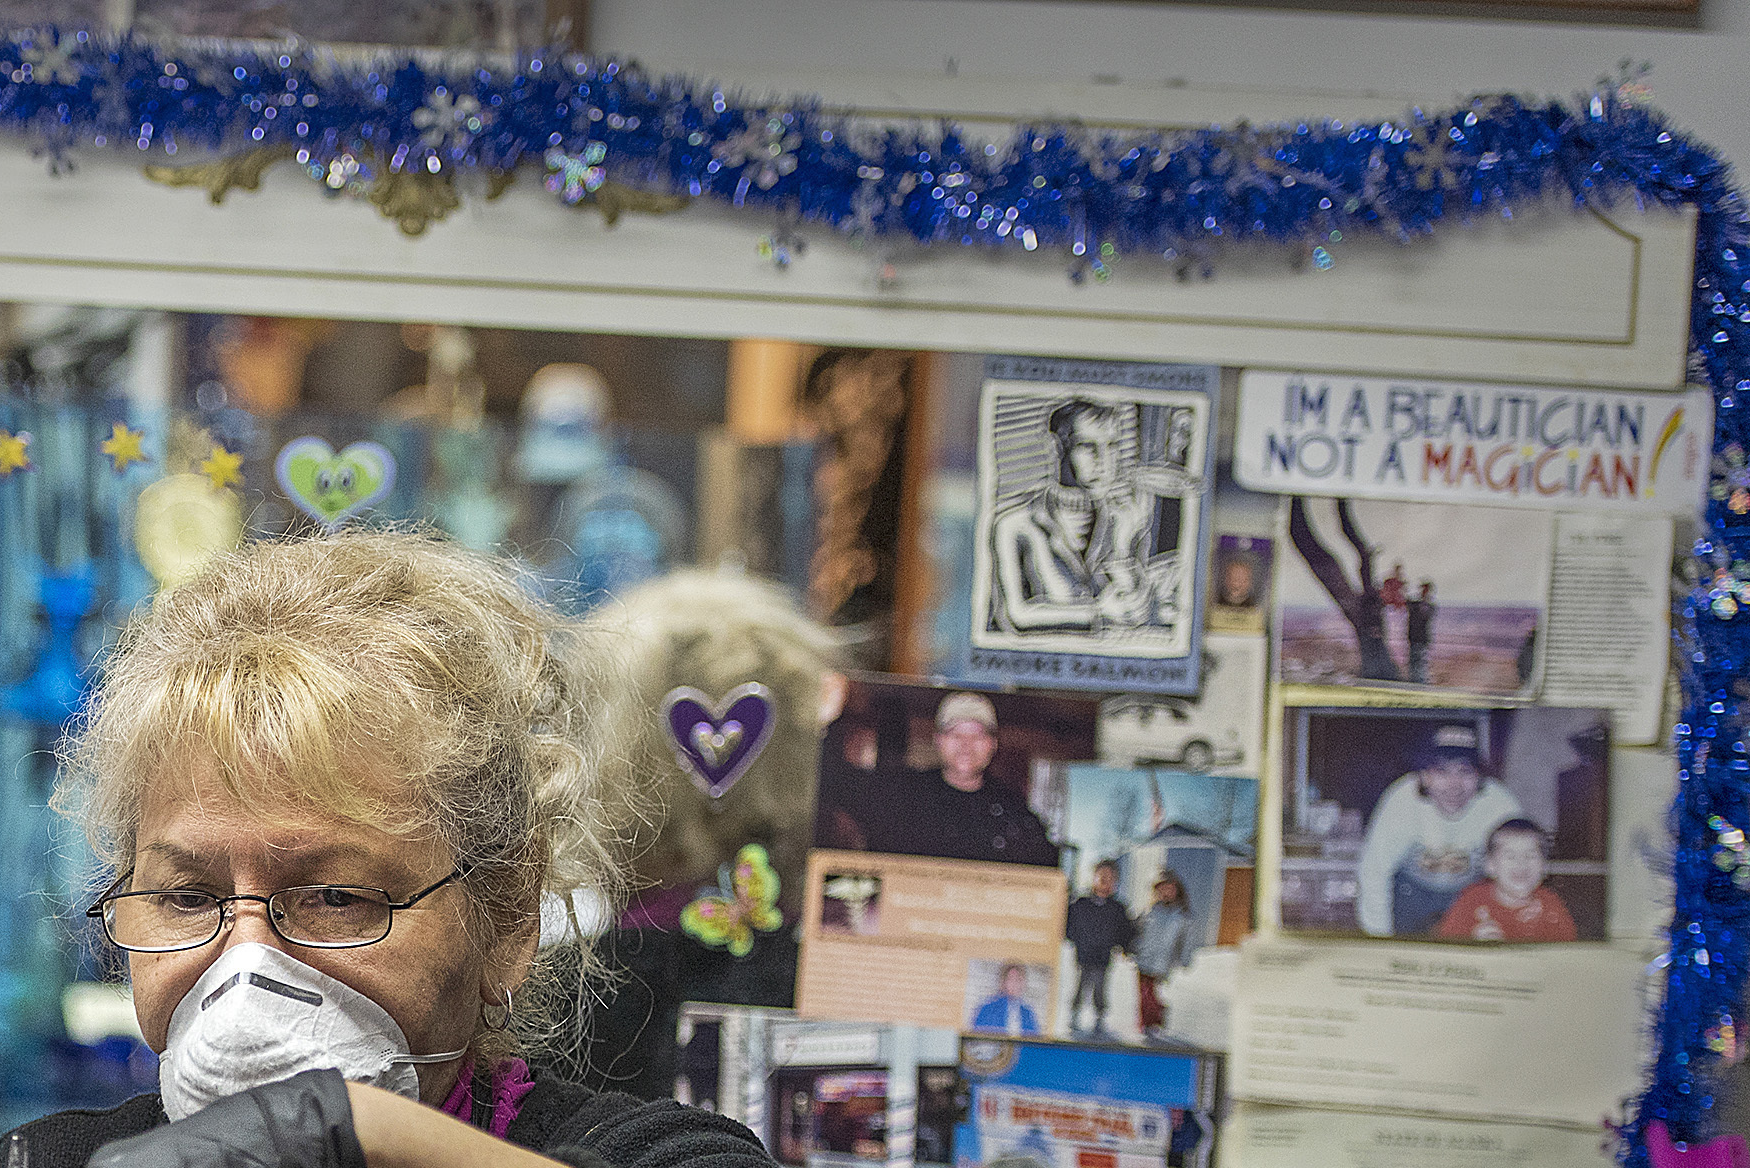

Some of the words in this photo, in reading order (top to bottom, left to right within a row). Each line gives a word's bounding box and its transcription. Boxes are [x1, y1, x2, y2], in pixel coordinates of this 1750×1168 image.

[1341, 383, 1372, 428] A
[1384, 386, 1645, 449] BEAUTICIAN
[1263, 432, 1363, 480] NOT
[1374, 434, 1407, 486] A
